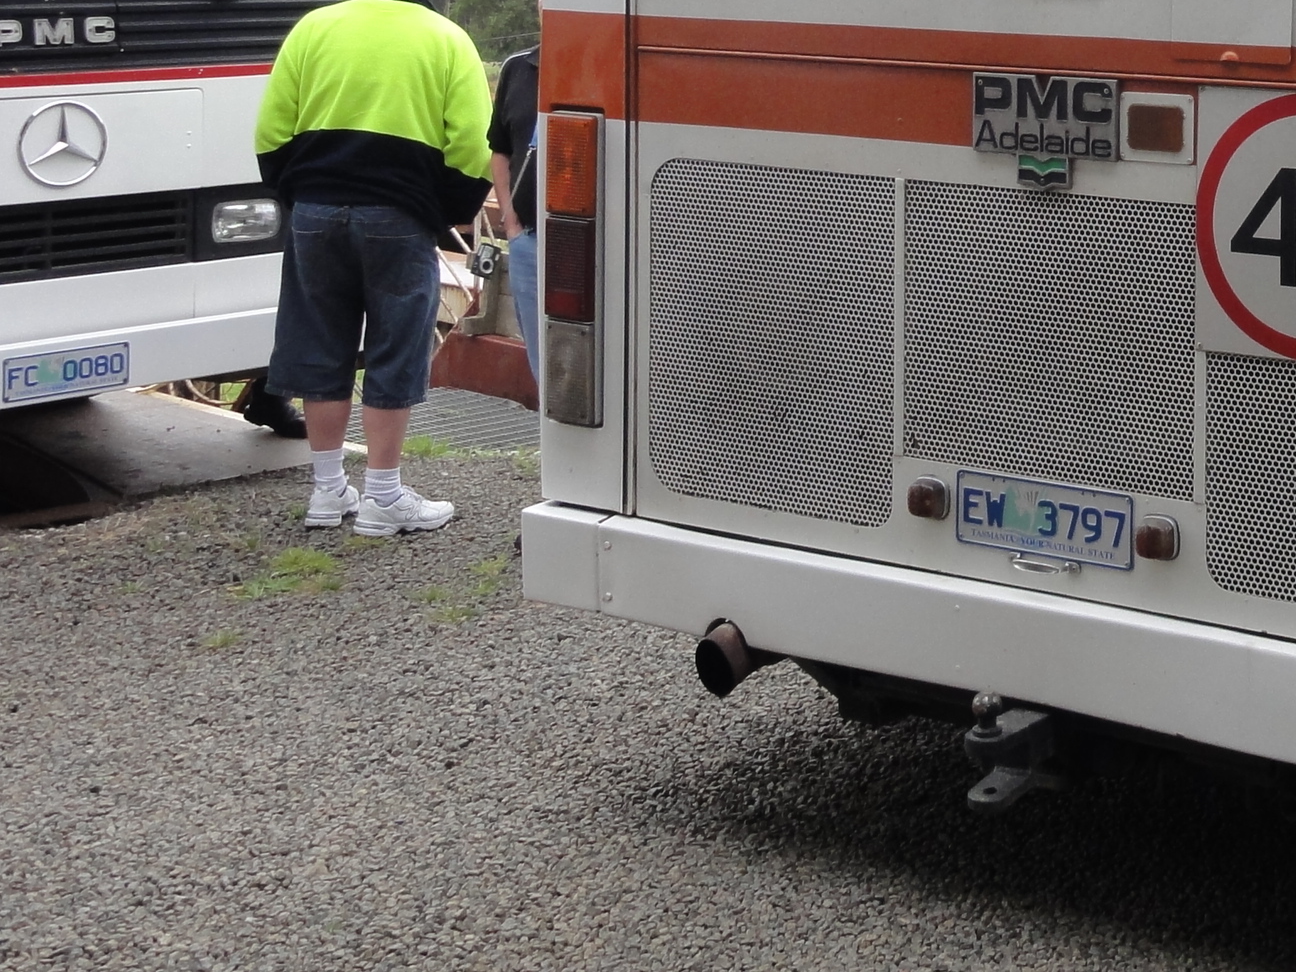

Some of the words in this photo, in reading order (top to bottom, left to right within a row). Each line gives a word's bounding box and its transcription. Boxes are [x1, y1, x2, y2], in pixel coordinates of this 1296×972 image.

[0, 16, 116, 46] PMC
[974, 75, 1113, 123] PMC
[974, 119, 1112, 158] Adelaide
[8, 365, 39, 389] FC
[62, 352, 125, 382] 0080
[963, 487, 1007, 528] EW
[1037, 499, 1126, 548] 3797
[1020, 537, 1045, 548] YOUR
[1045, 541, 1086, 556] NATURAL
[1087, 549, 1115, 560] STATE
